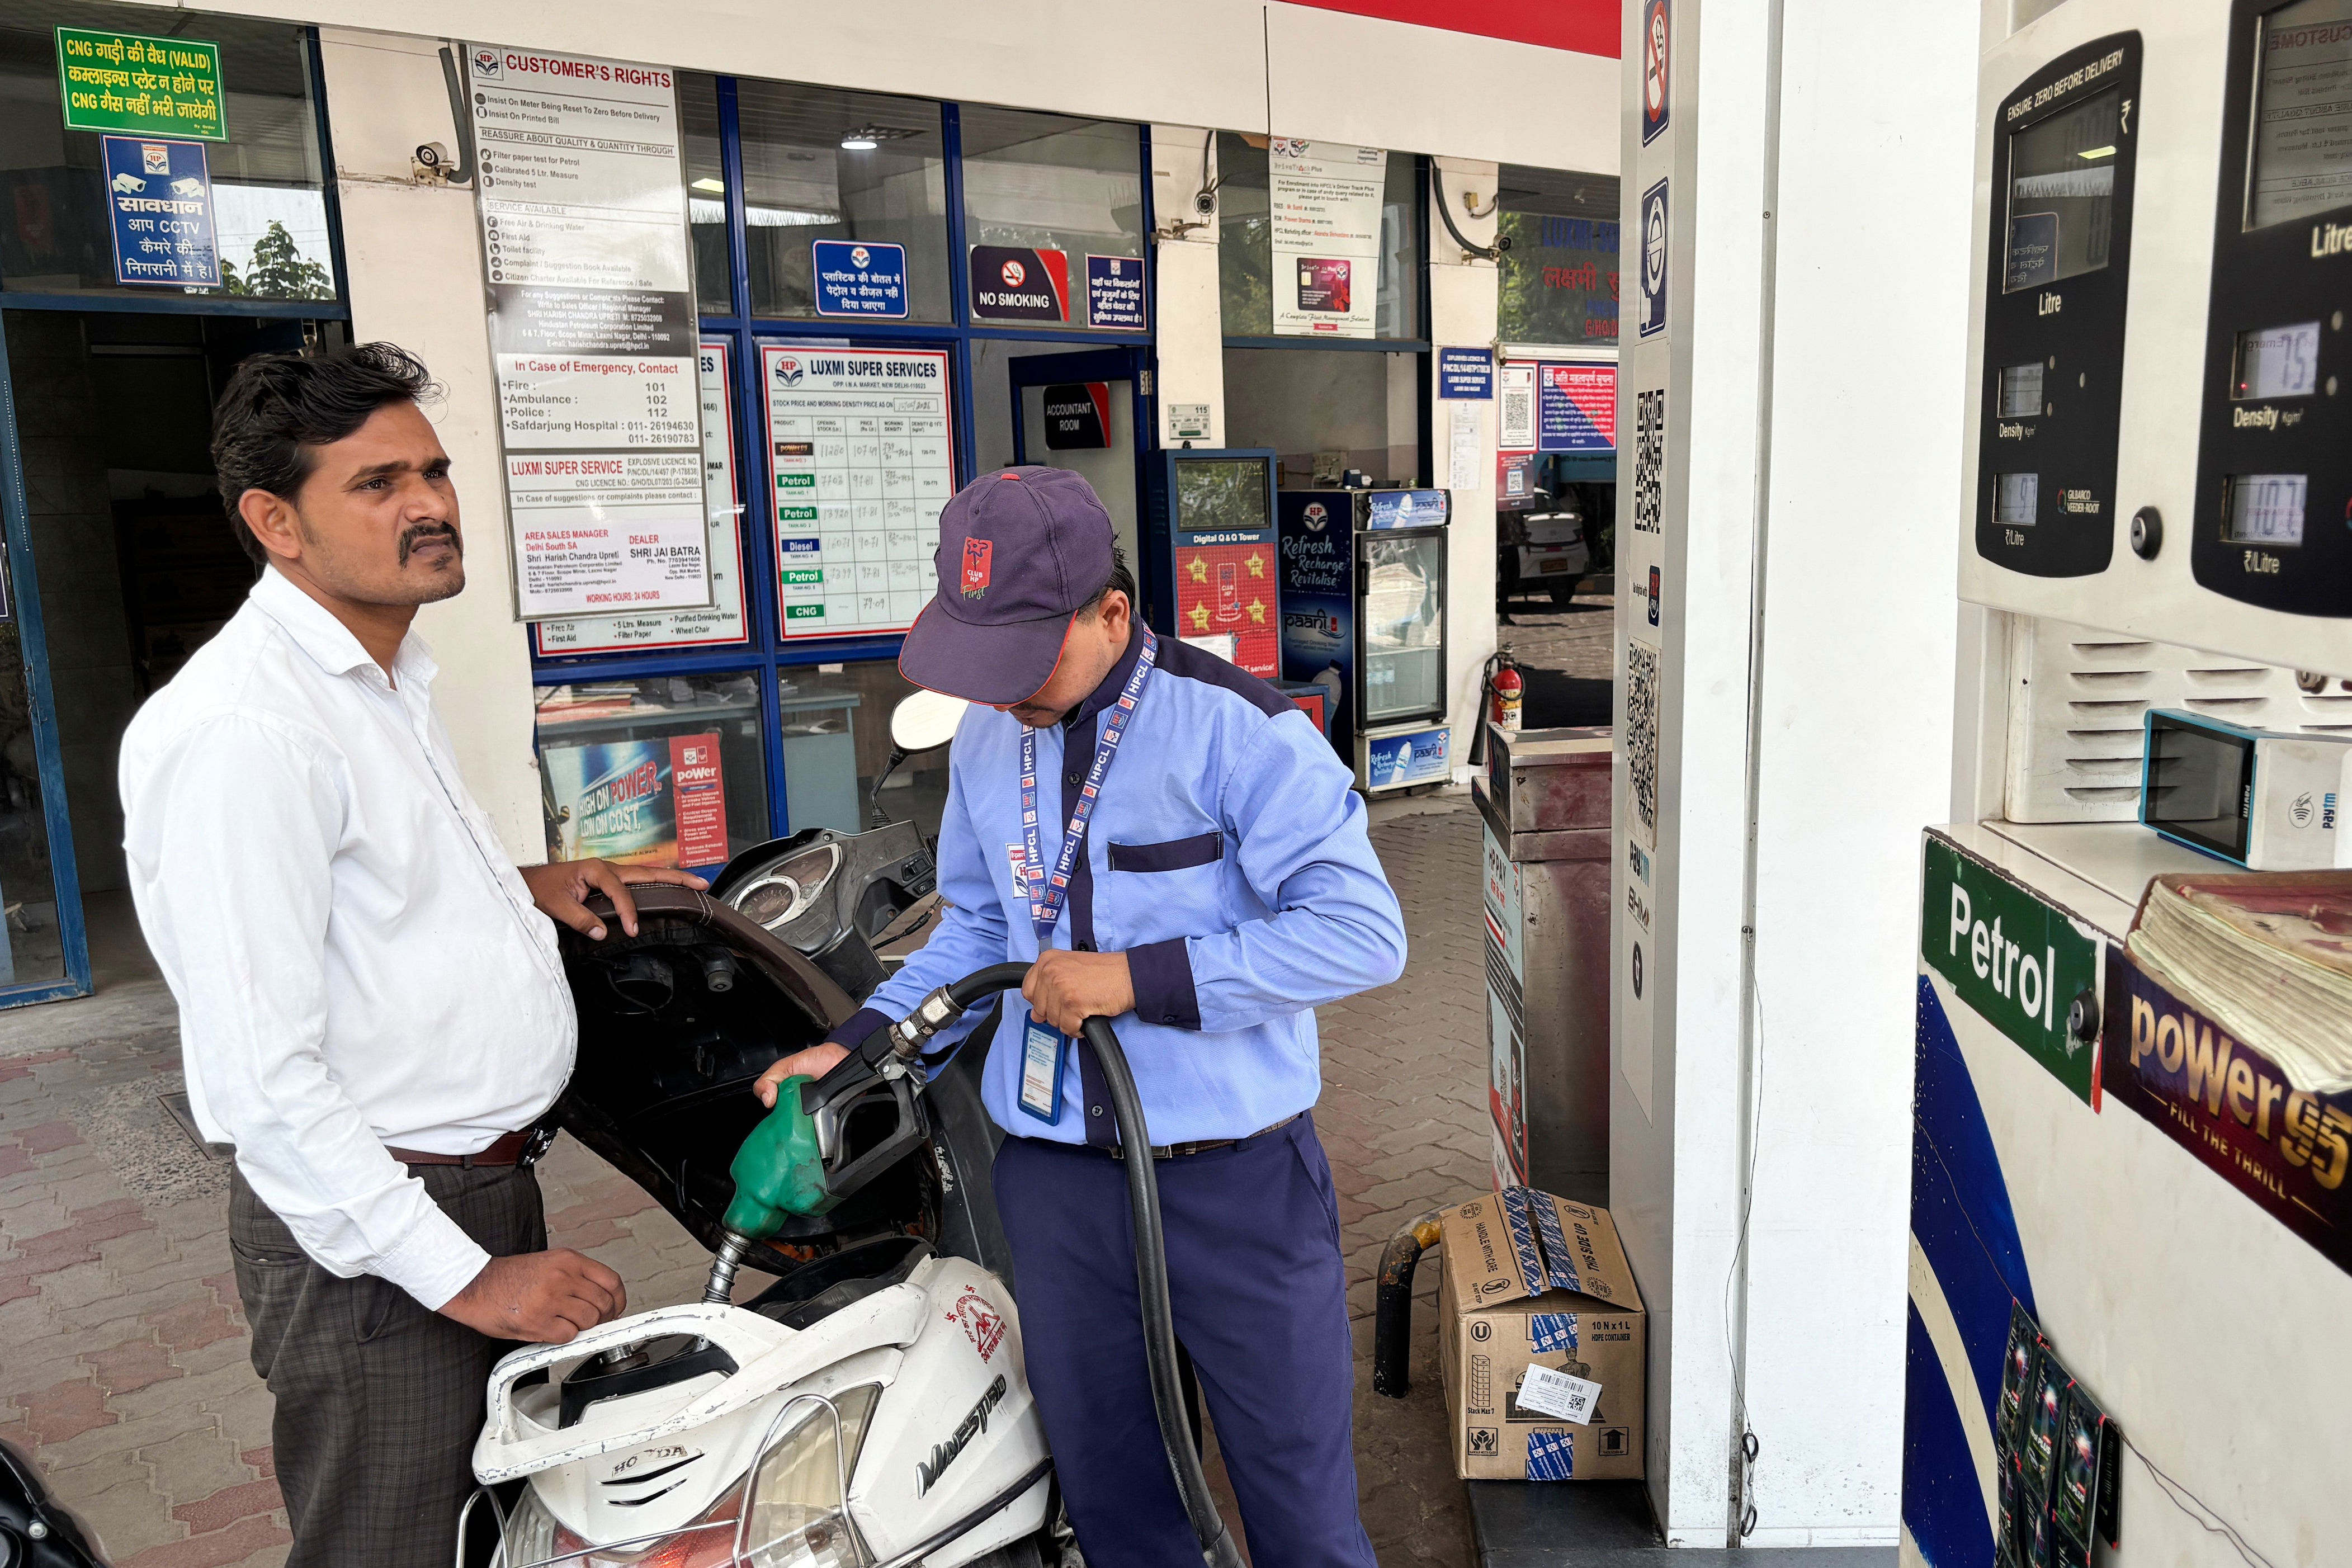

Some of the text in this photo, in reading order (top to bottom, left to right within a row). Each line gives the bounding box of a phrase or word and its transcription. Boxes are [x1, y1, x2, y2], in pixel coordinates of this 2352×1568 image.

[67, 39, 210, 73] CNG गाड़ी की वैध (VALID)
[506, 54, 670, 87] CUSTOMER'S RIGHTS
[131, 69, 157, 89] प्लेट
[158, 75, 169, 90] न
[171, 71, 195, 93] होने
[197, 79, 214, 95] पर
[2008, 48, 2124, 121] ENSURE ZERO BEFORE DELIVERY
[72, 90, 216, 120] CNG गैस नहीं भरी जायेगी
[489, 110, 508, 118] Insist
[521, 113, 546, 122] Printed
[481, 129, 525, 141] REASSURE
[527, 134, 552, 143] ABOUT
[555, 137, 587, 147] QUALITY
[597, 141, 634, 151] QUANTITY
[636, 145, 672, 154] THROUGH
[117, 197, 204, 215] सावधान
[128, 219, 200, 234] आप CCTV
[139, 238, 193, 255] कैमरे की
[125, 259, 177, 277] निगरानी
[182, 260, 193, 277] में
[858, 272, 870, 283] की
[826, 284, 847, 299] पेट्रोल
[841, 298, 858, 309] दिया
[979, 291, 1050, 310] NO SMOKING
[2038, 292, 2062, 317] Litre
[515, 361, 678, 375] In Case of Emergency, Contact
[811, 360, 936, 377] LUXMI SUPER SERVICES
[508, 380, 528, 390] Fire
[645, 382, 664, 391] 101
[509, 394, 570, 403] Ambulance
[646, 395, 666, 404] 102
[510, 407, 544, 416] Police
[648, 408, 667, 417] 112
[1045, 401, 1092, 417] ACCOUNTANT
[1057, 418, 1081, 432] ROOM
[2233, 405, 2279, 431] Density
[511, 420, 570, 432] Safdarjung
[574, 421, 617, 432] Hospital
[1999, 422, 2023, 441] Density
[512, 460, 622, 475] LUXMI SUPER SERVICE
[782, 475, 811, 487] Petrol
[2067, 489, 2091, 501] GILBARCO
[785, 508, 813, 519] Petrol
[2067, 502, 2100, 514] VEEDER-ROOT
[525, 529, 608, 540] AREA SALES MANAGER
[629, 535, 659, 544] DEALER
[1193, 535, 1217, 544] Digital
[630, 546, 700, 558] SHRI JAI BATRA
[788, 540, 814, 551] Diesel
[789, 570, 818, 582] Petrol
[967, 569, 983, 578] CLUB
[586, 593, 612, 603] WORKING
[634, 592, 641, 601] 24
[642, 591, 660, 600] HOURS
[962, 584, 988, 601] First
[795, 606, 817, 616] CNG
[1128, 664, 1148, 695] HPCL
[1090, 749, 1111, 781] HPCL
[579, 792, 596, 818] HIGH
[597, 785, 609, 811] ON
[580, 818, 594, 838] LOW
[596, 813, 608, 835] ON
[1029, 829, 1039, 863] HPCL
[1059, 838, 1076, 871] HPCL
[1949, 882, 2055, 1032] Petrol
[2170, 1102, 2286, 1200] FILL THE THRILL
[1476, 1222, 1499, 1273] HANDLE WITH CARE
[1574, 1223, 1600, 1272] THIS SIDE UP
[1592, 1321, 1602, 1330] 10
[1603, 1321, 1609, 1330] N
[1618, 1321, 1622, 1330] 1
[1625, 1321, 1631, 1330] L
